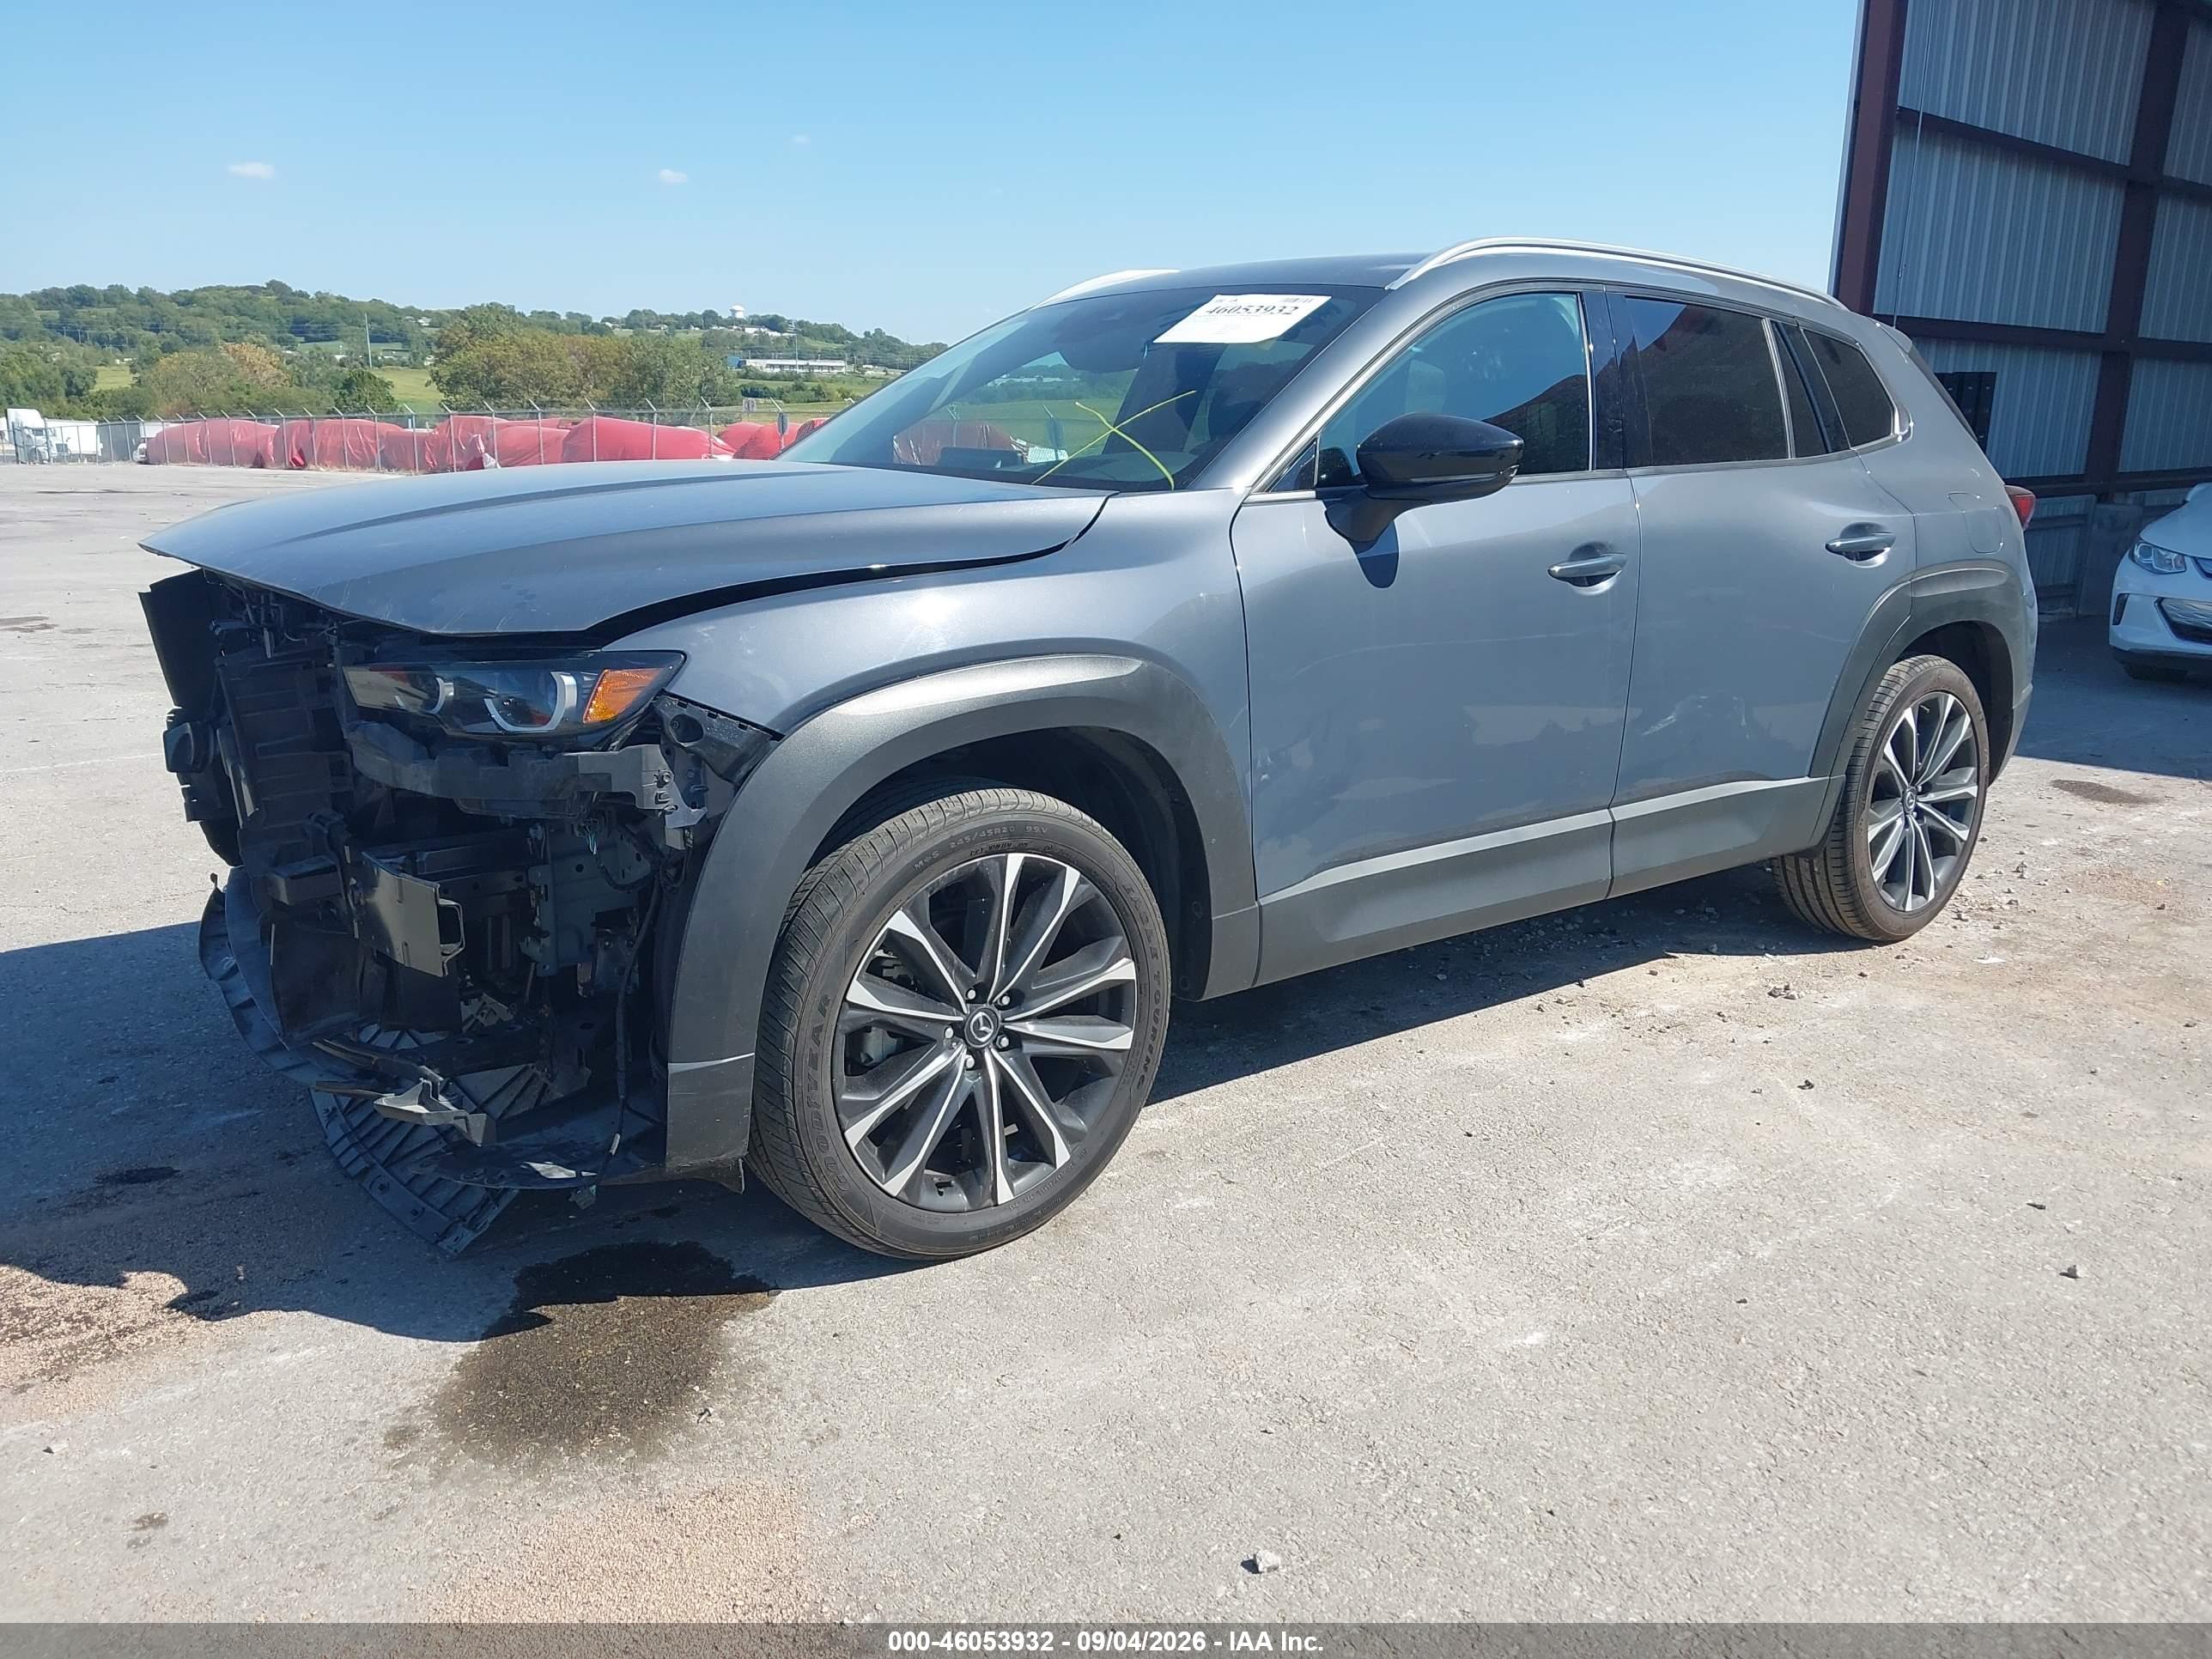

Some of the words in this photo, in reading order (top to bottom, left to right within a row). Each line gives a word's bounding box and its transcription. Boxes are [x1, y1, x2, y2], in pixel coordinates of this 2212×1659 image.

[949, 825, 1016, 849] 245/45R20
[1024, 825, 1048, 834] 99V
[1135, 970, 1162, 1091] TOURING
[806, 994, 850, 1192] GOODYEAR
